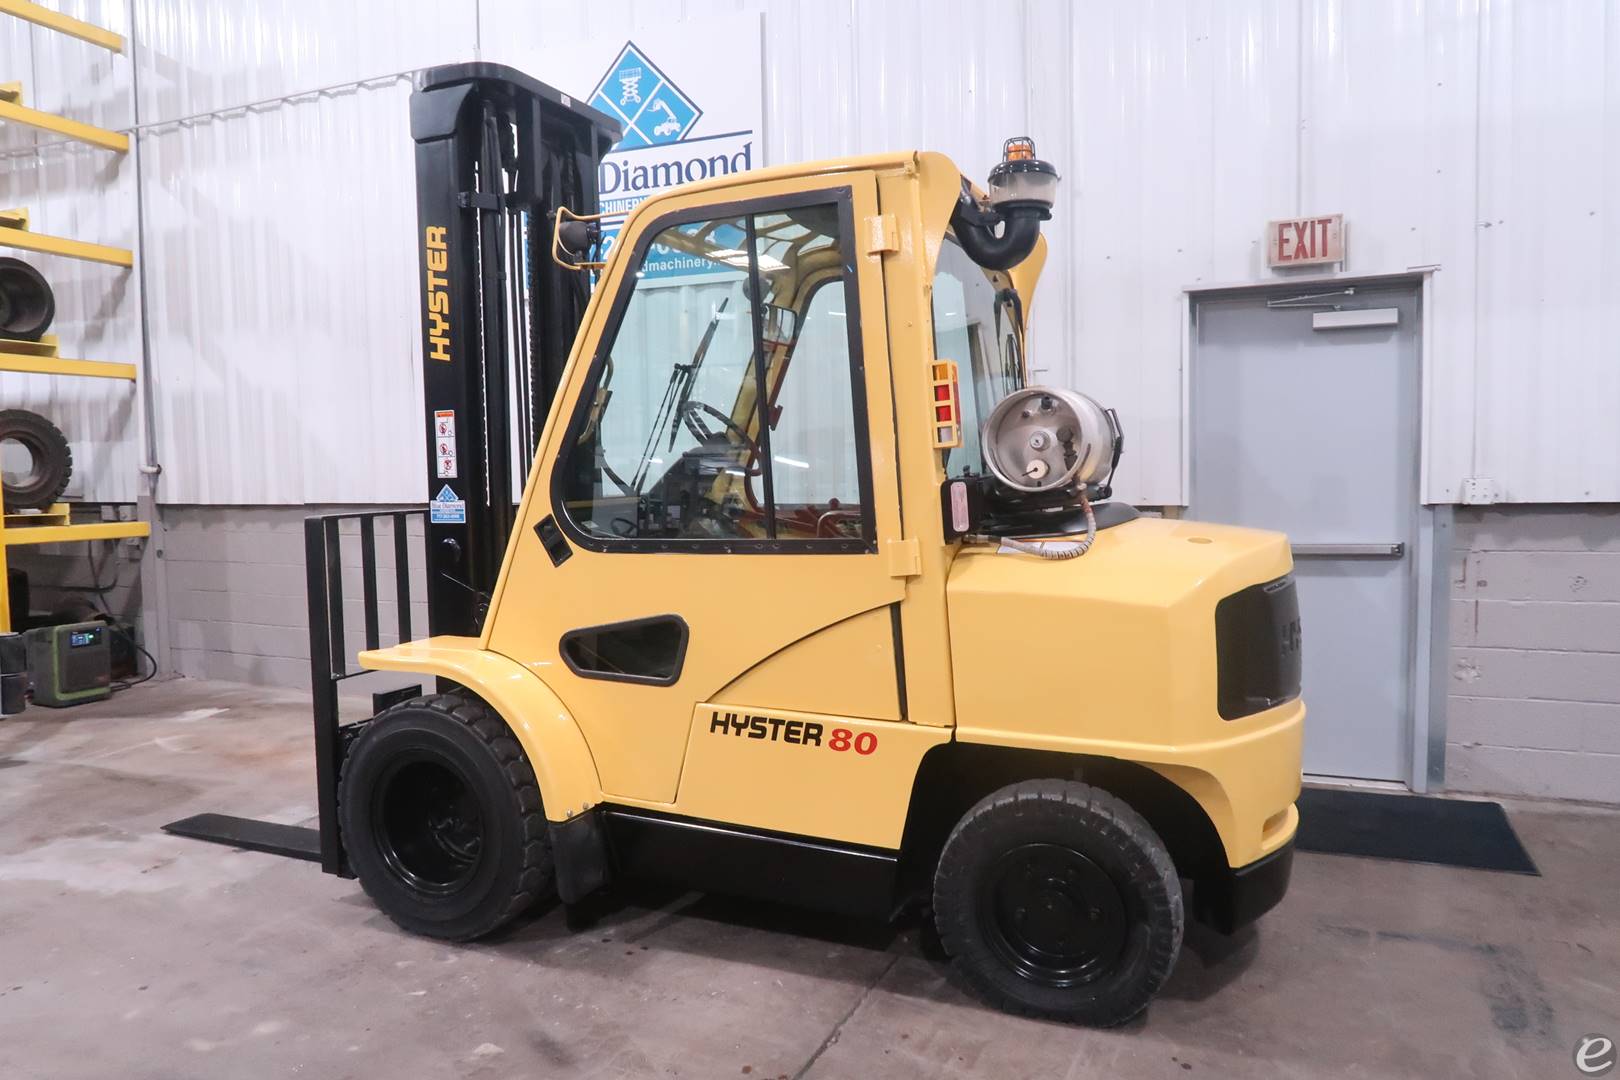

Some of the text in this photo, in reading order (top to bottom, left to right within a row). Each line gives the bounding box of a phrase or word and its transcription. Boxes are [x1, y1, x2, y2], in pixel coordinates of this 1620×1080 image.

[599, 141, 752, 195] Diamond
[1278, 219, 1333, 261] EXIT
[426, 226, 451, 361] HYSTER
[710, 711, 879, 756] HYSTER 80
